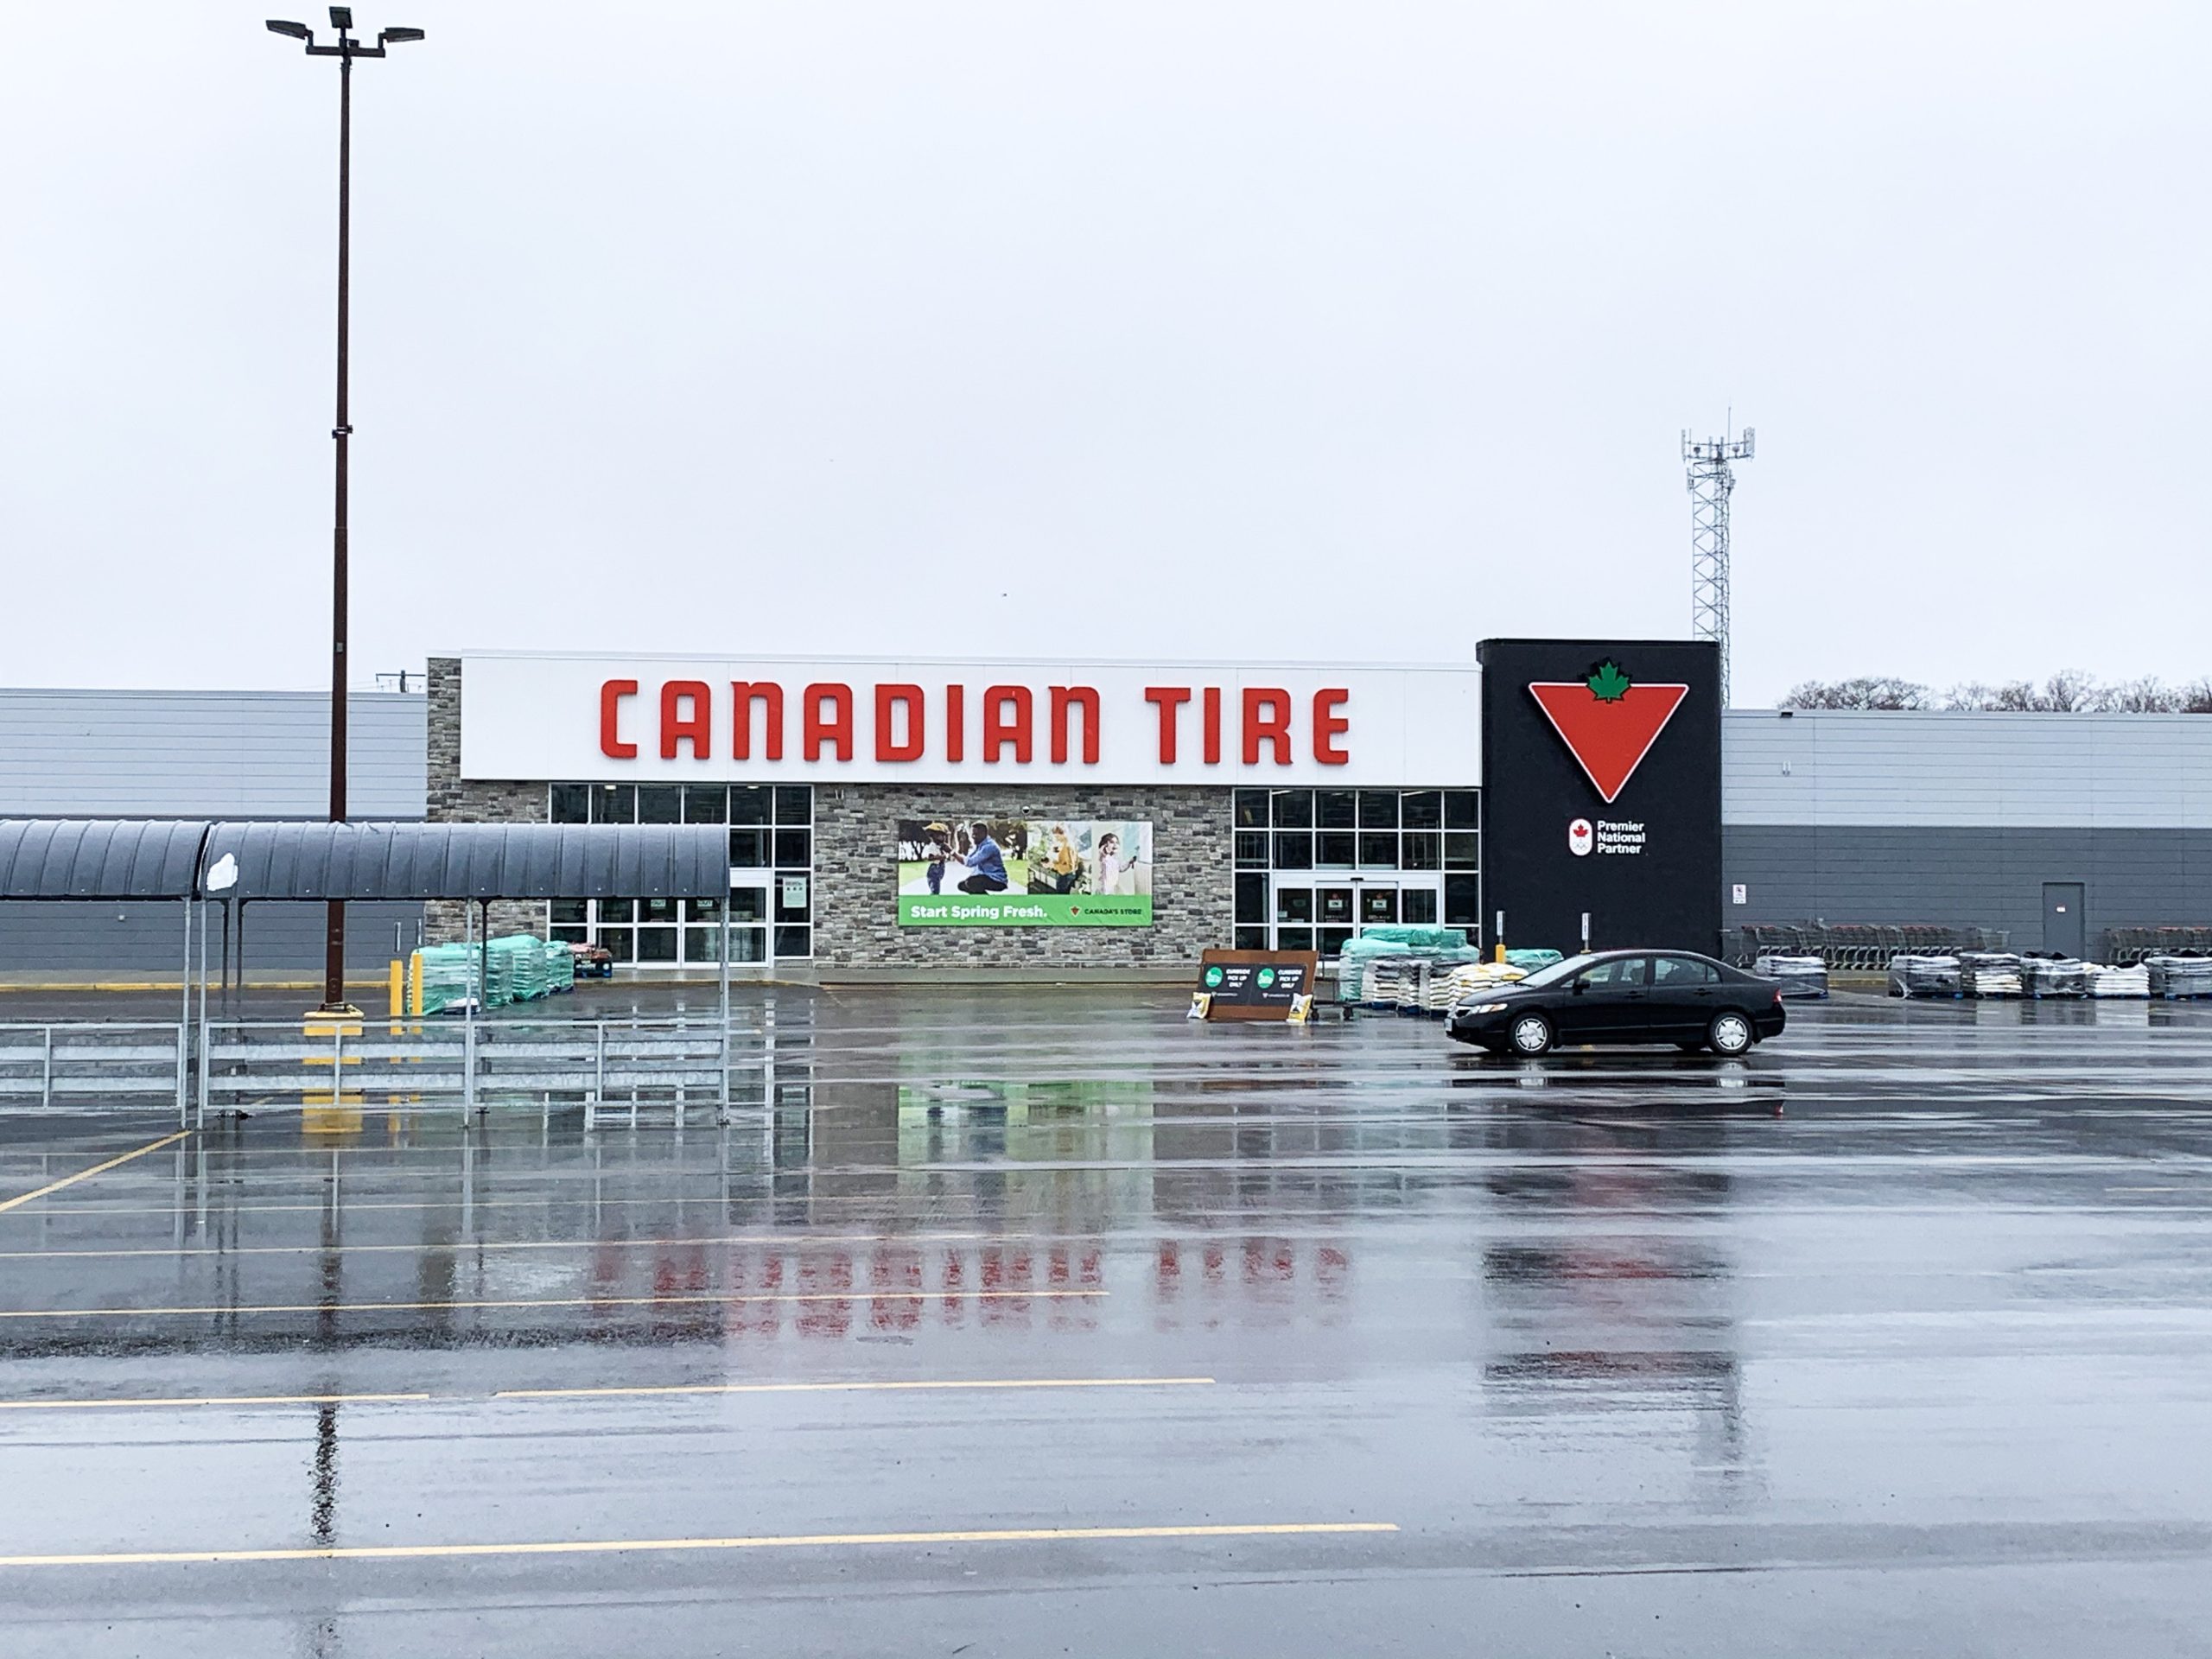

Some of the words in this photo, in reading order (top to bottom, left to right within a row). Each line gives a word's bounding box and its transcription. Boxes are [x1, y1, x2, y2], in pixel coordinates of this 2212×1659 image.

[600, 679, 1099, 764] CANADIAN
[1144, 688, 1349, 766] TIRE
[1597, 820, 1645, 832] Premier
[1597, 832, 1646, 843] National
[1597, 843, 1642, 854] Partner
[911, 905, 948, 918] Start
[950, 905, 1000, 920] Spring
[1003, 905, 1048, 918] Fresh.
